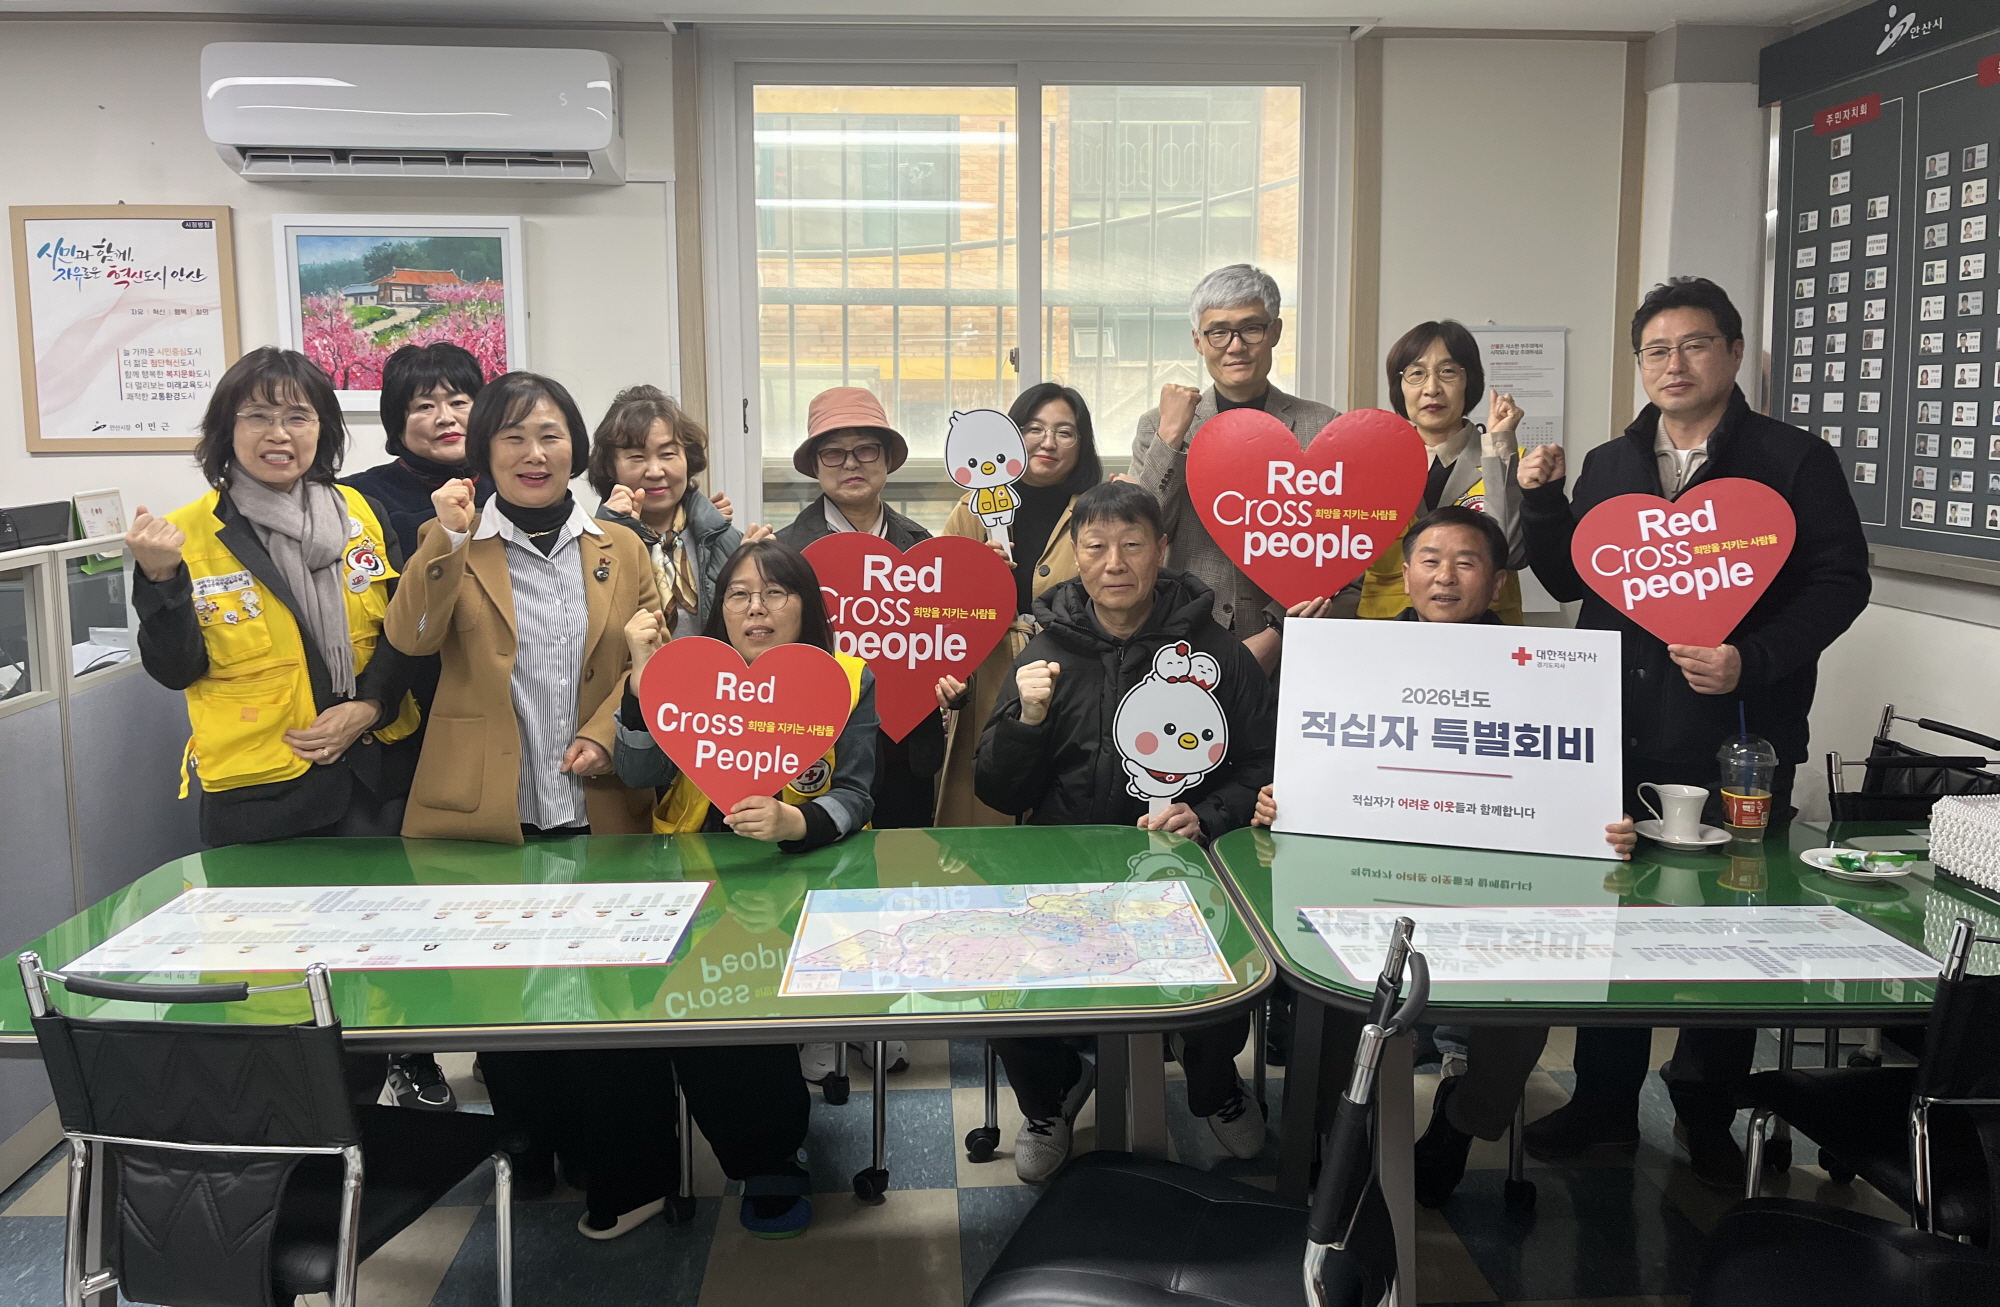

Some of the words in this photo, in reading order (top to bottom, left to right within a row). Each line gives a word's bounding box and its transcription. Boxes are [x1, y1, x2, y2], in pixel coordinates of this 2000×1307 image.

[1910, 17, 1943, 40] 안산시
[1825, 103, 1868, 126] 주민자치회
[37, 237, 91, 270] 시민과
[53, 265, 102, 292] 자유로운
[107, 265, 166, 290] 혁신도시
[171, 267, 208, 283] 안산
[131, 308, 144, 316] 자유
[152, 308, 166, 316] 혁신
[174, 308, 187, 316] 행복
[123, 348, 131, 356] 늘
[132, 348, 155, 356] 가까운
[157, 347, 202, 356] 시민중심도시
[124, 359, 131, 367] 더
[133, 359, 149, 367] 젊은
[150, 359, 195, 367] 첨단혁신도시
[124, 370, 140, 378] 함께
[141, 370, 164, 378] 행복한
[166, 370, 211, 378] 복지문화도시
[125, 381, 133, 389] 더
[135, 381, 164, 389] 멀리보는
[167, 381, 212, 389] 미래교육도시
[126, 392, 149, 401] 쾌적한
[151, 392, 195, 400] 교통환경도시
[1267, 461, 1343, 495] Red
[1213, 491, 1313, 527] Cross
[1315, 508, 1341, 520] 희망을
[1343, 509, 1369, 520] 지키는
[1370, 509, 1397, 521] 사람들
[1637, 499, 1717, 541] Red
[1244, 525, 1373, 567] people
[1693, 542, 1720, 555] 희망을
[1721, 538, 1749, 551] 지키는
[1750, 534, 1778, 547] 사람들
[1591, 540, 1692, 576] Cross
[863, 554, 942, 593] Red
[1622, 556, 1754, 610] people
[913, 607, 940, 619] 희망을
[941, 607, 969, 619] 지키는
[970, 608, 997, 620] 사람들
[833, 624, 967, 669] people
[1536, 649, 1598, 663] 대한적십자사
[715, 672, 776, 704] Red
[1401, 687, 1492, 708] 2026년도
[656, 702, 744, 736] Cross
[747, 720, 775, 734] 희망을
[777, 722, 805, 736] 지키는
[806, 723, 835, 737] 사람들
[1300, 710, 1419, 751] 적십자
[1431, 717, 1595, 763] 특별회비
[694, 739, 799, 780] People
[1352, 794, 1395, 809] 적십자가
[1397, 797, 1430, 811] 어려운
[1433, 799, 1477, 815] 이웃들과
[1480, 803, 1536, 819] 함께합니다
